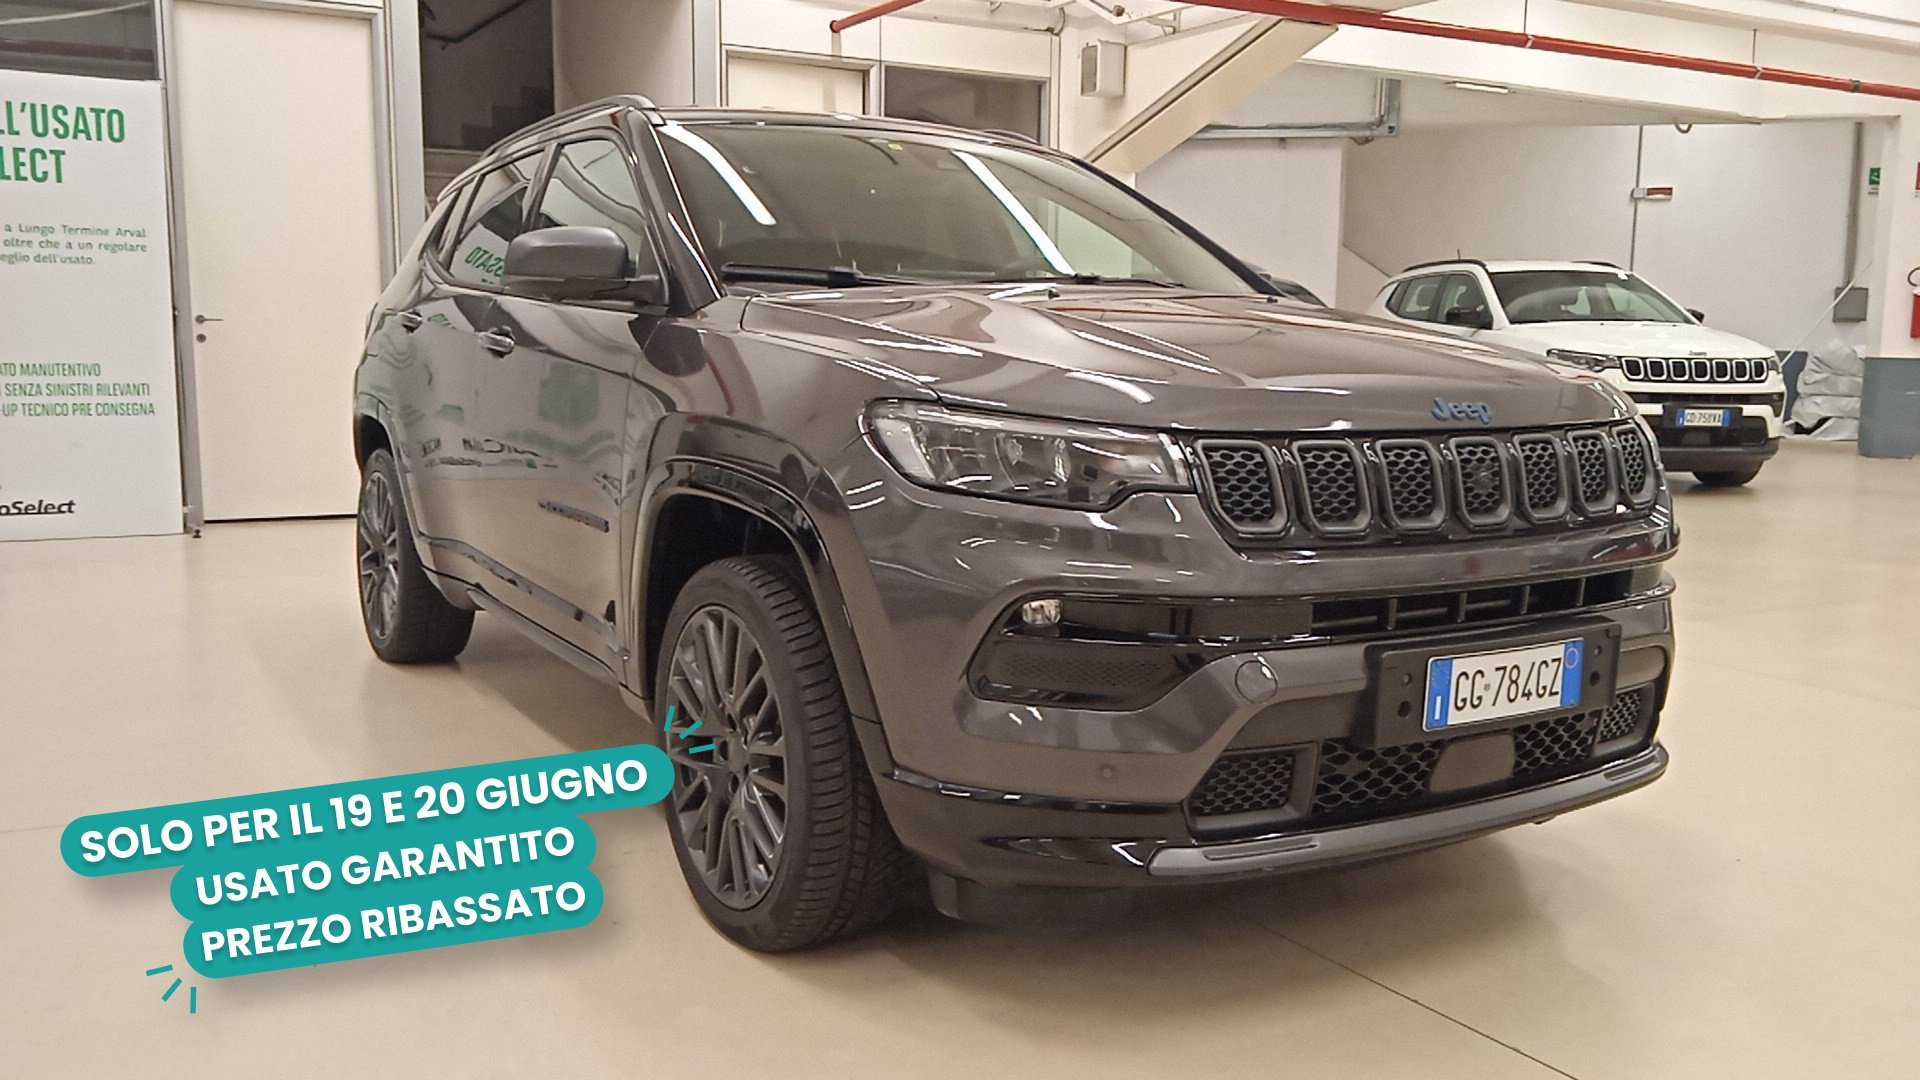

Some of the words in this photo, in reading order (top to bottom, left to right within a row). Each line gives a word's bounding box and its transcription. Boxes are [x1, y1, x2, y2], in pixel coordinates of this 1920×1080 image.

[0, 101, 125, 143] L'USATO
[4, 224, 12, 232] a
[19, 224, 55, 237] Lungo
[61, 224, 110, 236] Termine
[115, 228, 147, 238] Arval
[3, 238, 33, 248] oltre
[38, 239, 60, 249] che
[65, 242, 73, 250] a
[77, 242, 93, 250] un
[98, 242, 147, 254] regolare
[20, 363, 101, 377] MANUTENTIVO
[5, 383, 43, 397] SENZA
[45, 383, 93, 397] SINISTRI
[96, 383, 150, 397] RILEVANTI
[21, 403, 69, 417] TECNICO
[72, 403, 93, 417] PRE
[95, 402, 156, 417] CONSEGNA
[1431, 397, 1492, 425] Jeep
